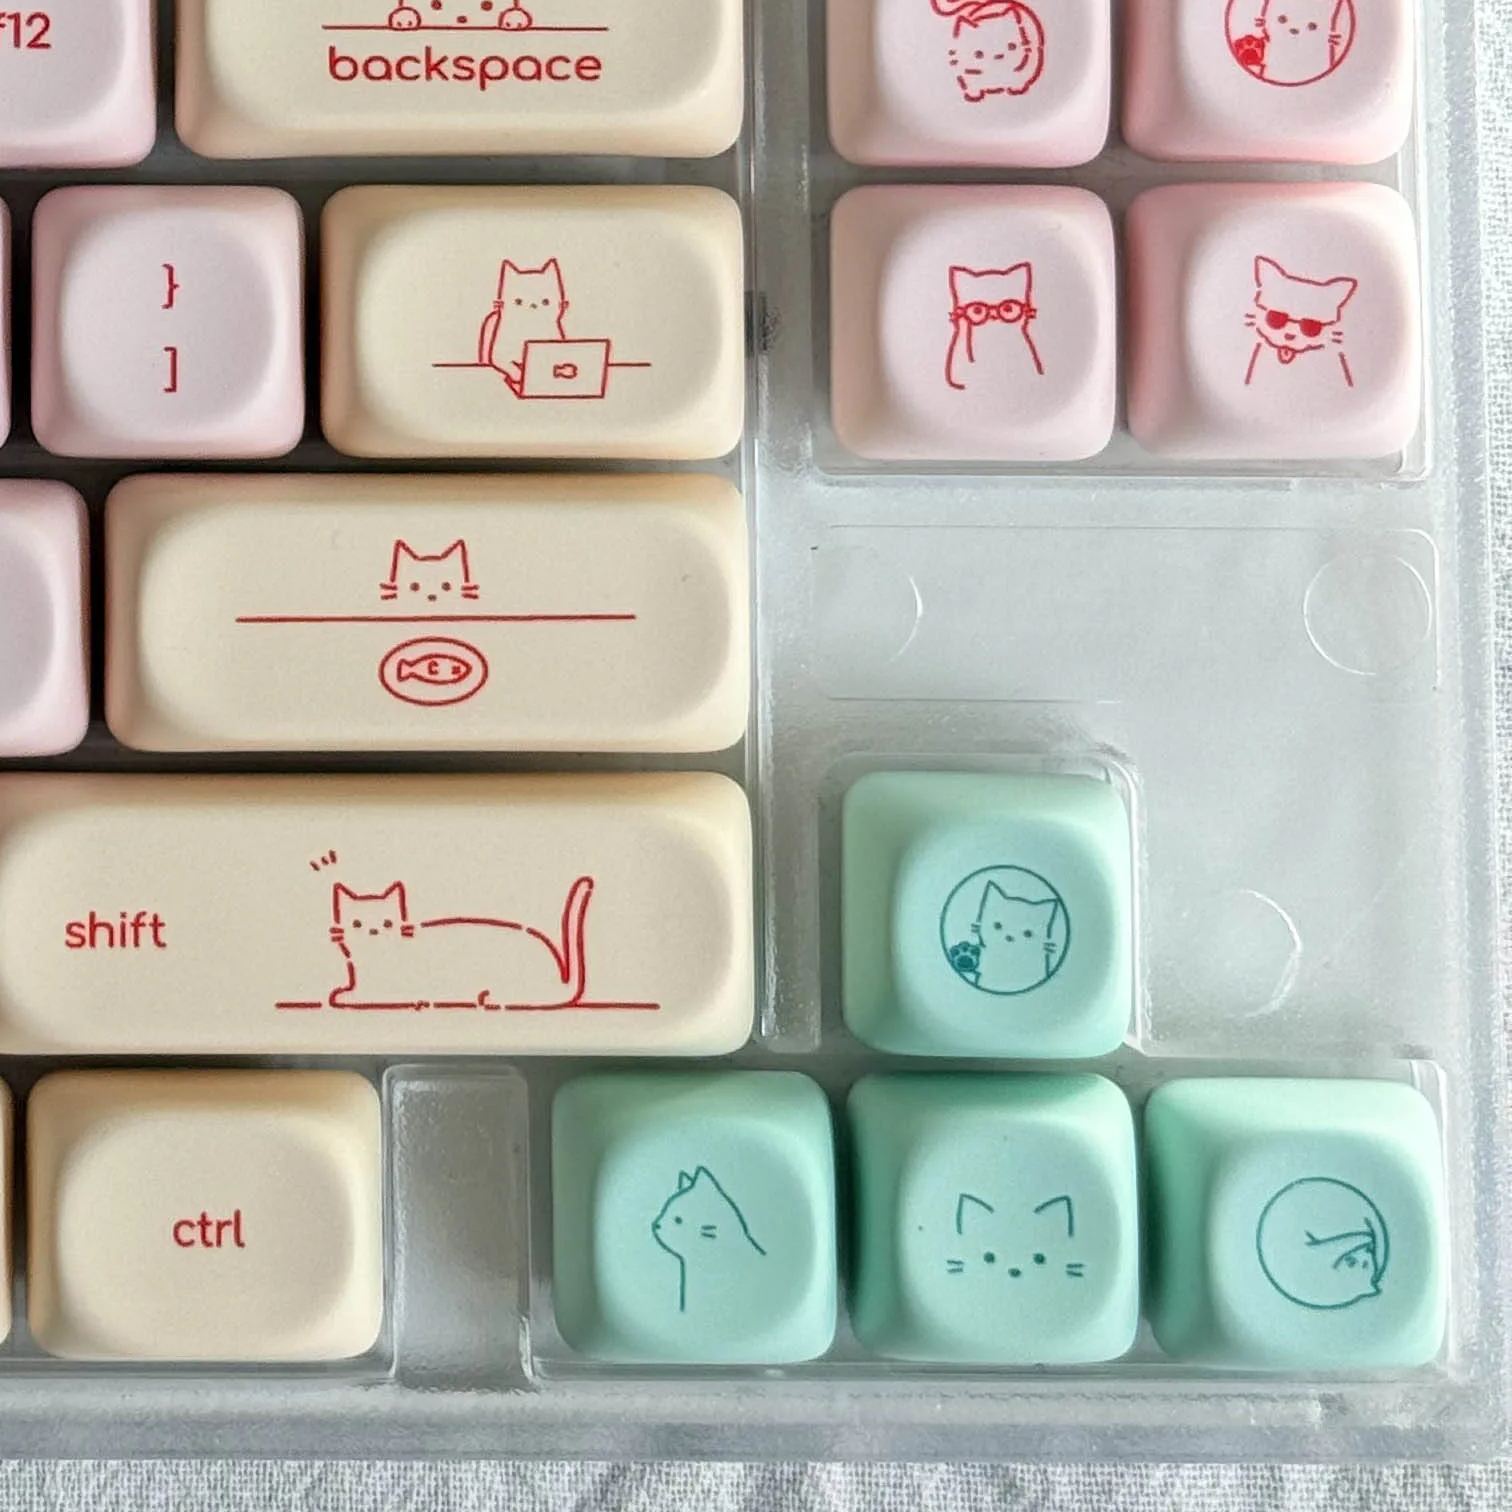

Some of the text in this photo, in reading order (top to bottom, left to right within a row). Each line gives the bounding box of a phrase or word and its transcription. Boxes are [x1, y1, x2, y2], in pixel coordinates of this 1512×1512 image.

[328, 46, 603, 91] backspace
[163, 264, 181, 310] }
[164, 346, 179, 394] ]
[65, 911, 167, 951] shift
[172, 1210, 246, 1250] ctrl
